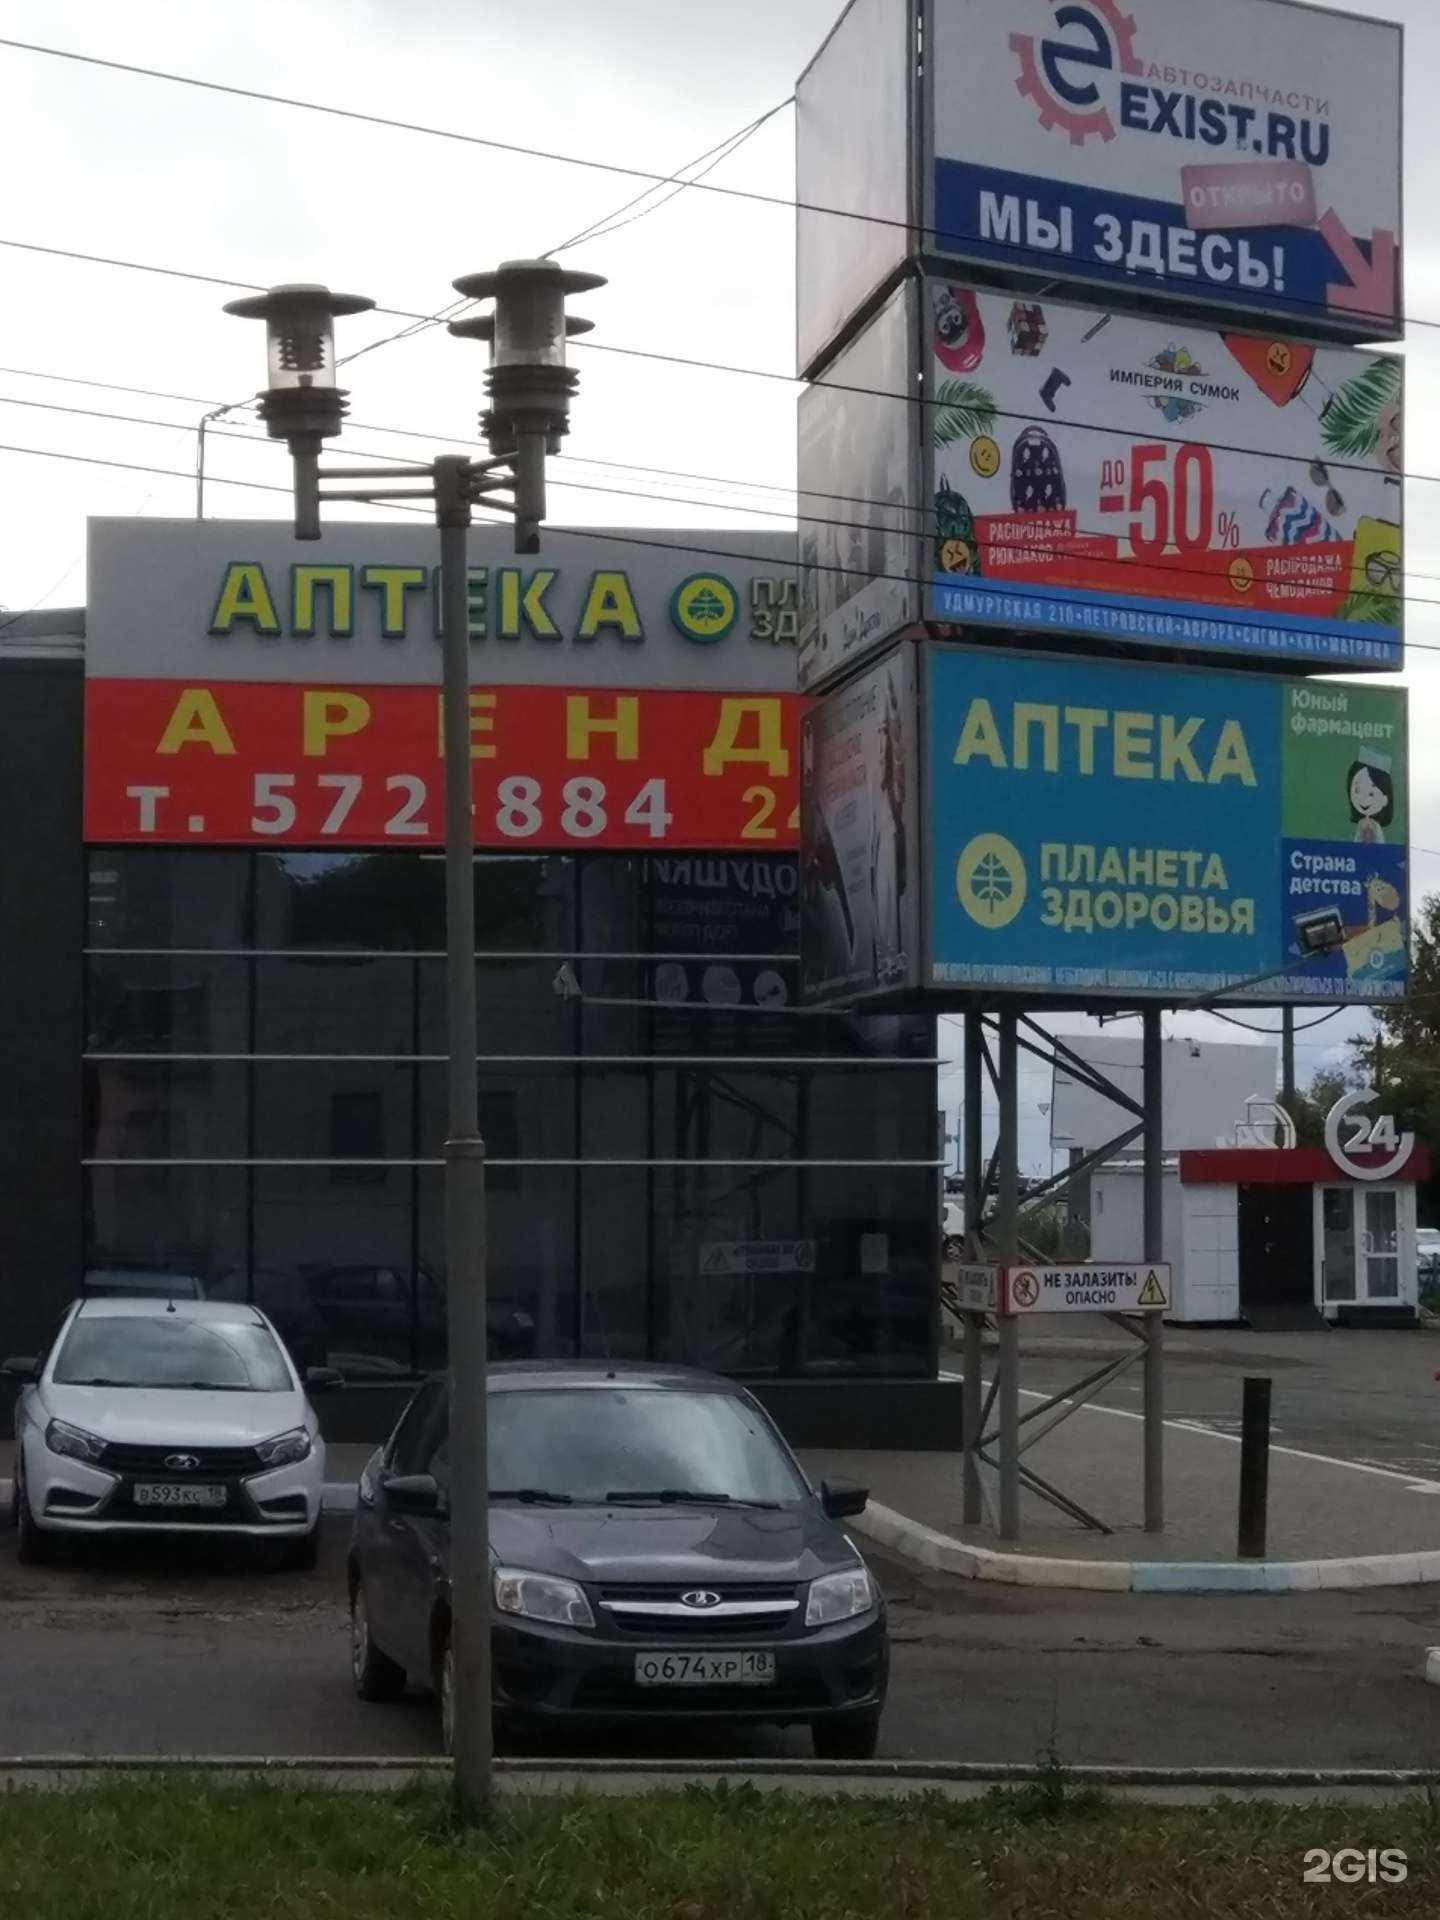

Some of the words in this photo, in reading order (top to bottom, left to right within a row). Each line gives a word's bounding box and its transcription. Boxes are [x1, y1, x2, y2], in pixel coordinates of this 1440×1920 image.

[1147, 62, 1330, 117] АВТОЗАПЧАСТИ
[1120, 81, 1330, 167] EXIST.RU
[979, 191, 1074, 254] МЫ
[1093, 213, 1286, 293] ЗДЕСЬ!
[1109, 368, 1184, 393] ИМПЕРИЯ
[1190, 381, 1241, 402] СУМОК
[207, 561, 647, 643] АПТЕКА
[1291, 687, 1348, 713] Юный
[155, 688, 791, 778] АРЕНД
[953, 698, 1258, 788] АПТЕКА
[1040, 843, 1229, 891] ПЛАНЕТА
[1290, 850, 1357, 874] Страна
[1289, 876, 1363, 895] детства
[1039, 887, 1255, 936] ЗДОРОВЬЯ
[1343, 1114, 1400, 1153] 24
[1044, 1272, 1062, 1288] НЕ
[1064, 1271, 1138, 1288] ЗАЛАЗИТЬ!
[1065, 1290, 1117, 1305] ОПАСНО
[643, 1655, 738, 1680] О674ХР
[745, 1653, 768, 1673] 18
